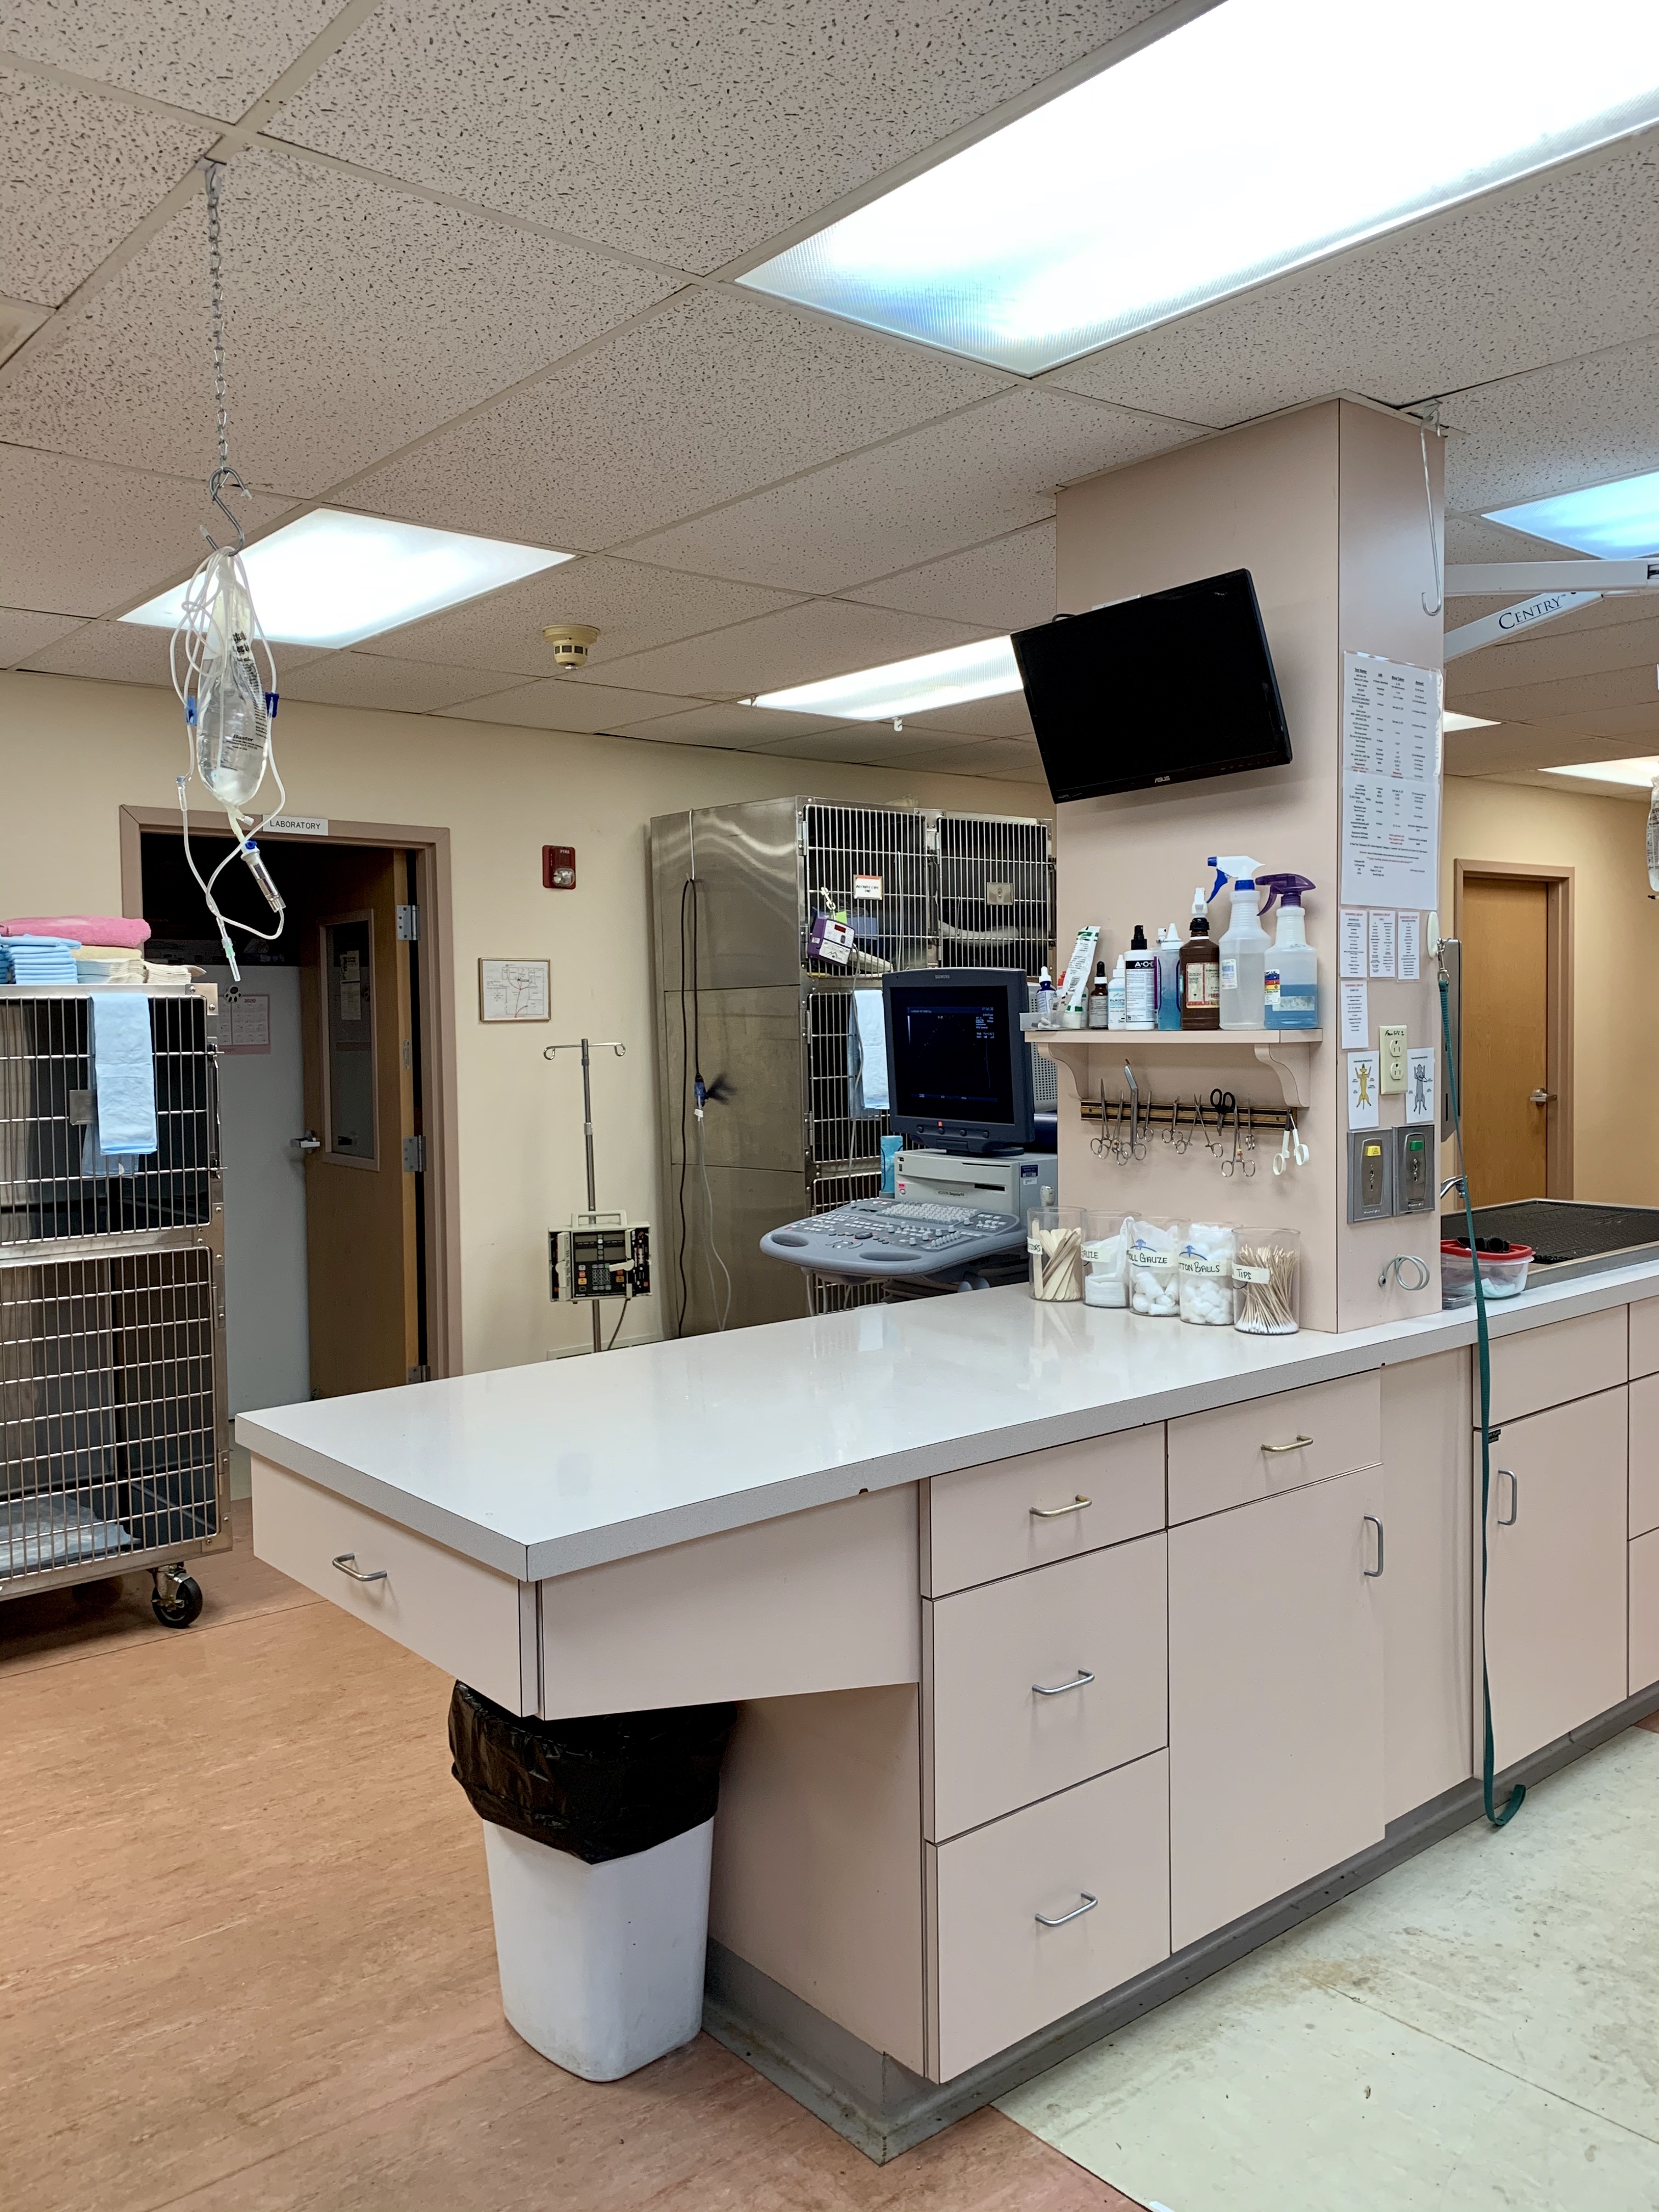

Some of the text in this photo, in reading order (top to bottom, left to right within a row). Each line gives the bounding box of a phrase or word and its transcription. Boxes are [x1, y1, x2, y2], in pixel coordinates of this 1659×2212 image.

[269, 820, 320, 830] LABORATORY
[1139, 1252, 1168, 1264] GAUZE
[1194, 1261, 1220, 1273] BALLS
[1236, 1268, 1251, 1280] TIPS
